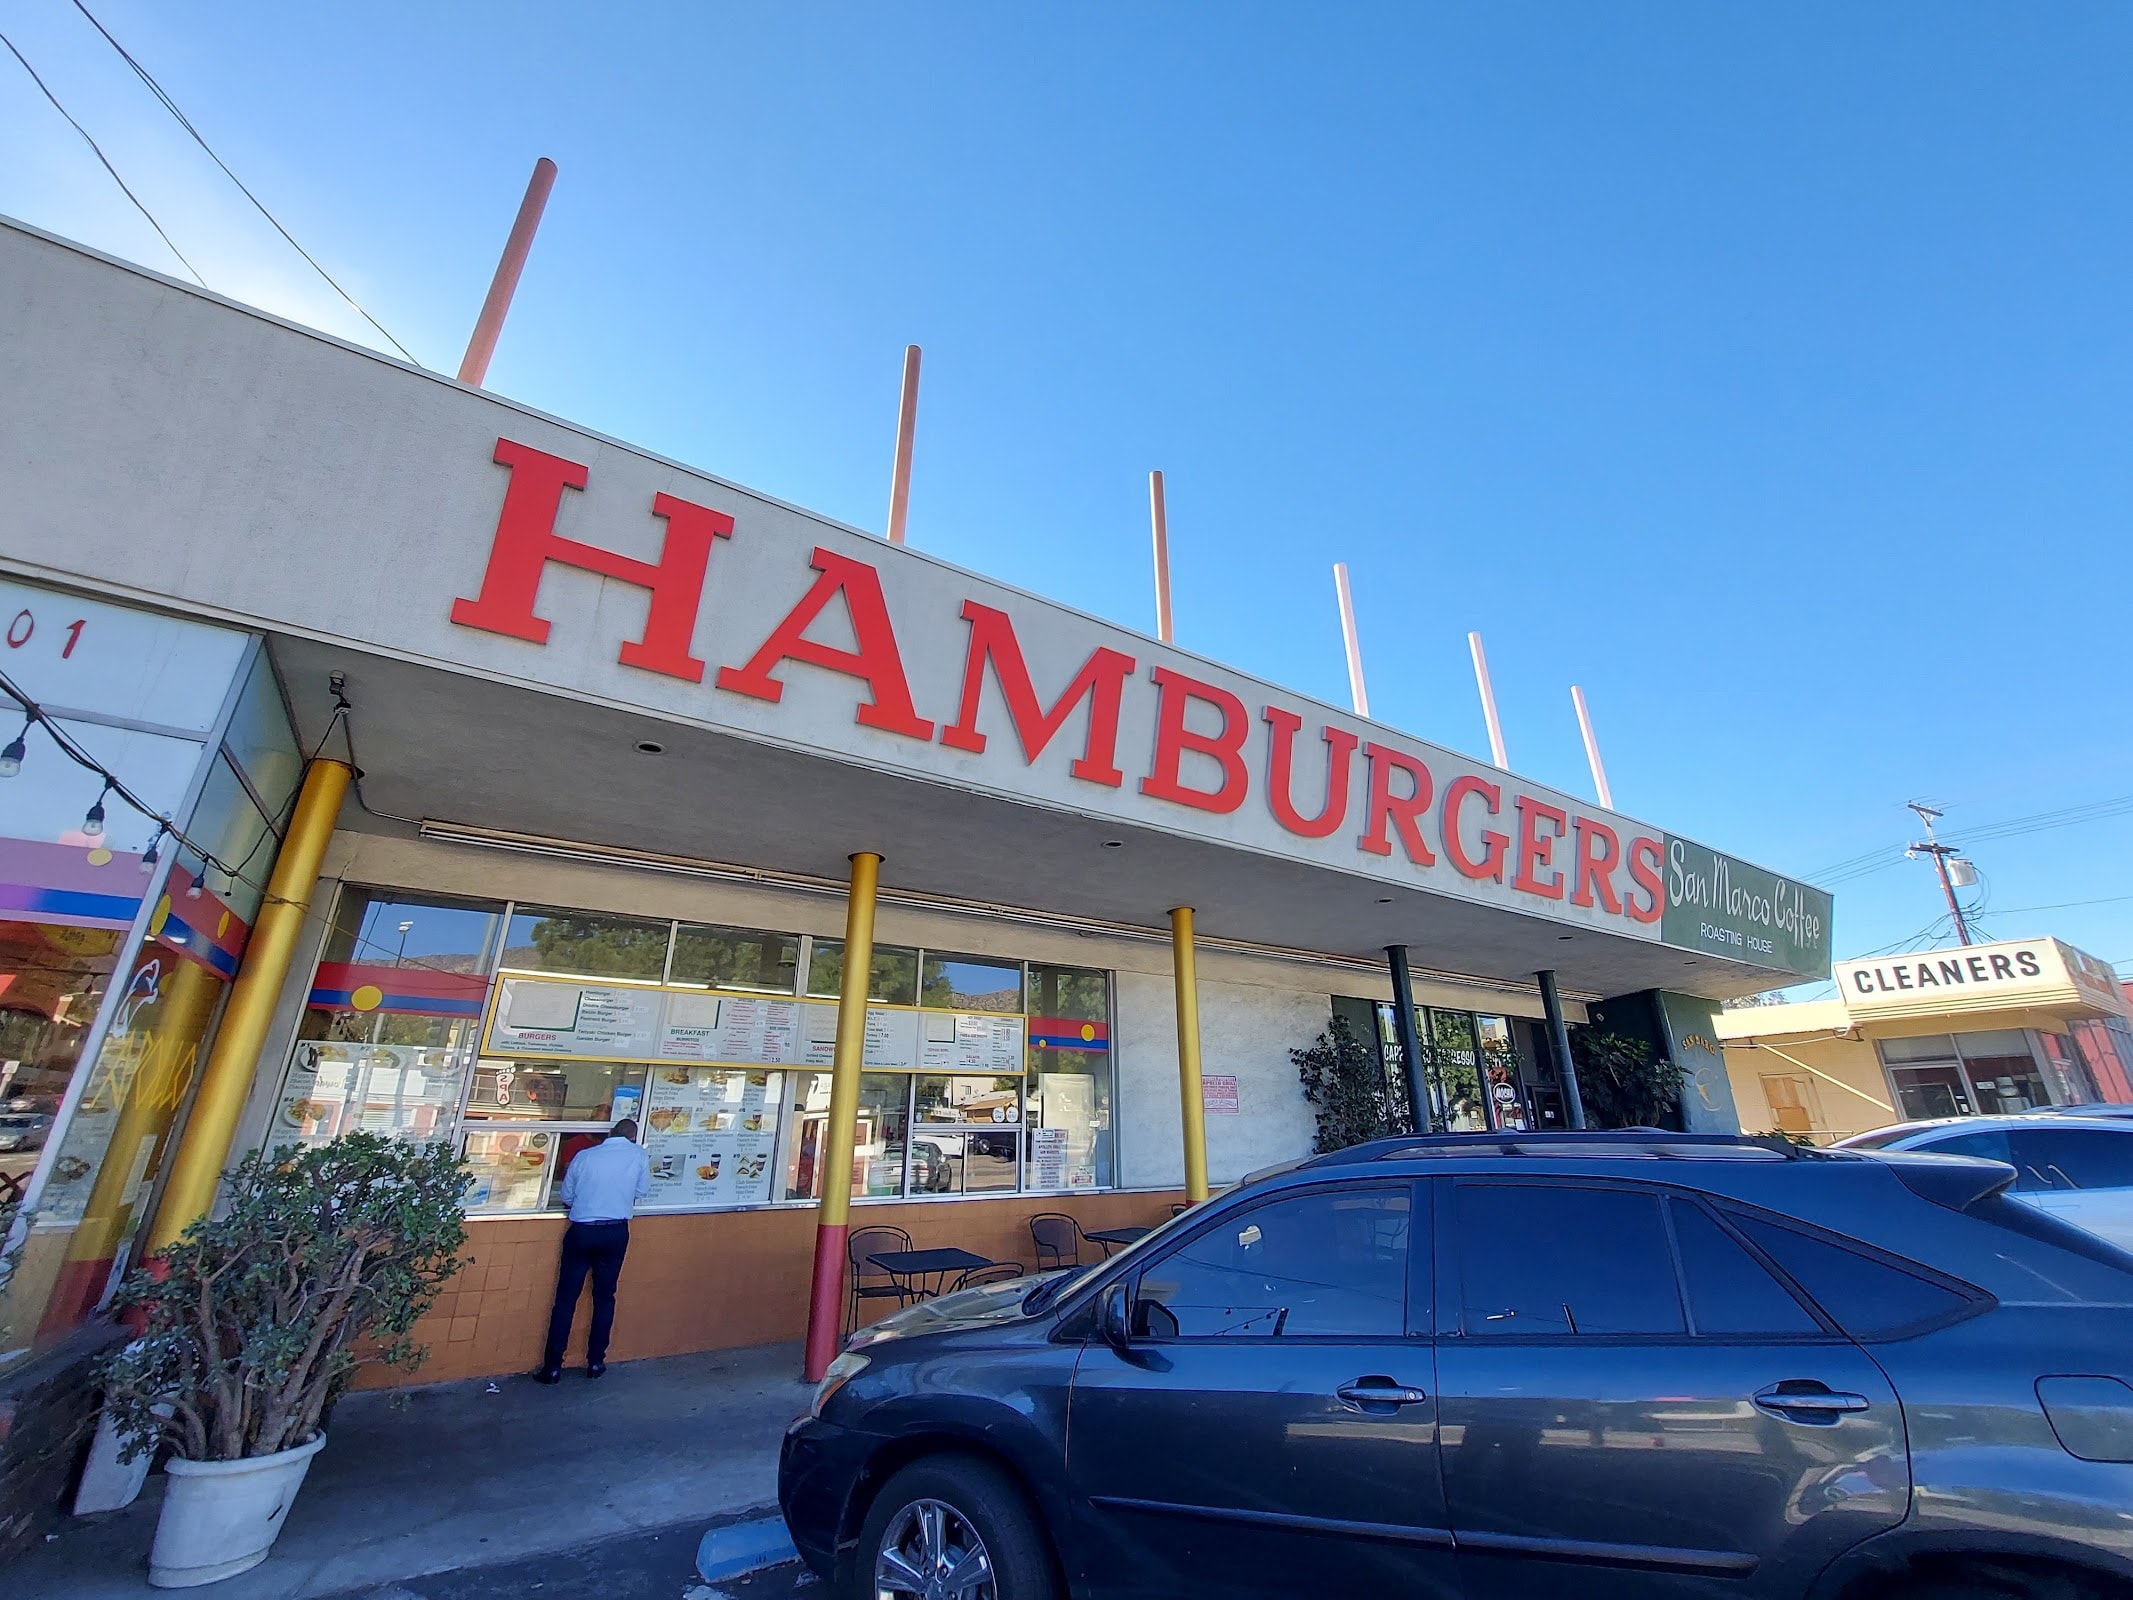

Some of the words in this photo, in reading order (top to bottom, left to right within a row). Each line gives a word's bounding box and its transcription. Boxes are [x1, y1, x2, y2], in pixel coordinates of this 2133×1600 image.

[450, 439, 1665, 922] HAMBURGERS
[1669, 839, 1709, 907] San
[1712, 855, 1770, 926] Marco
[1774, 879, 1820, 950] Coffee
[1700, 922, 1742, 946] ROASTING
[1746, 935, 1773, 954] HOUSE
[1853, 950, 2041, 994] CLEANERS
[518, 1032, 557, 1041] BURGERS
[671, 1028, 710, 1037] BREAKFAST
